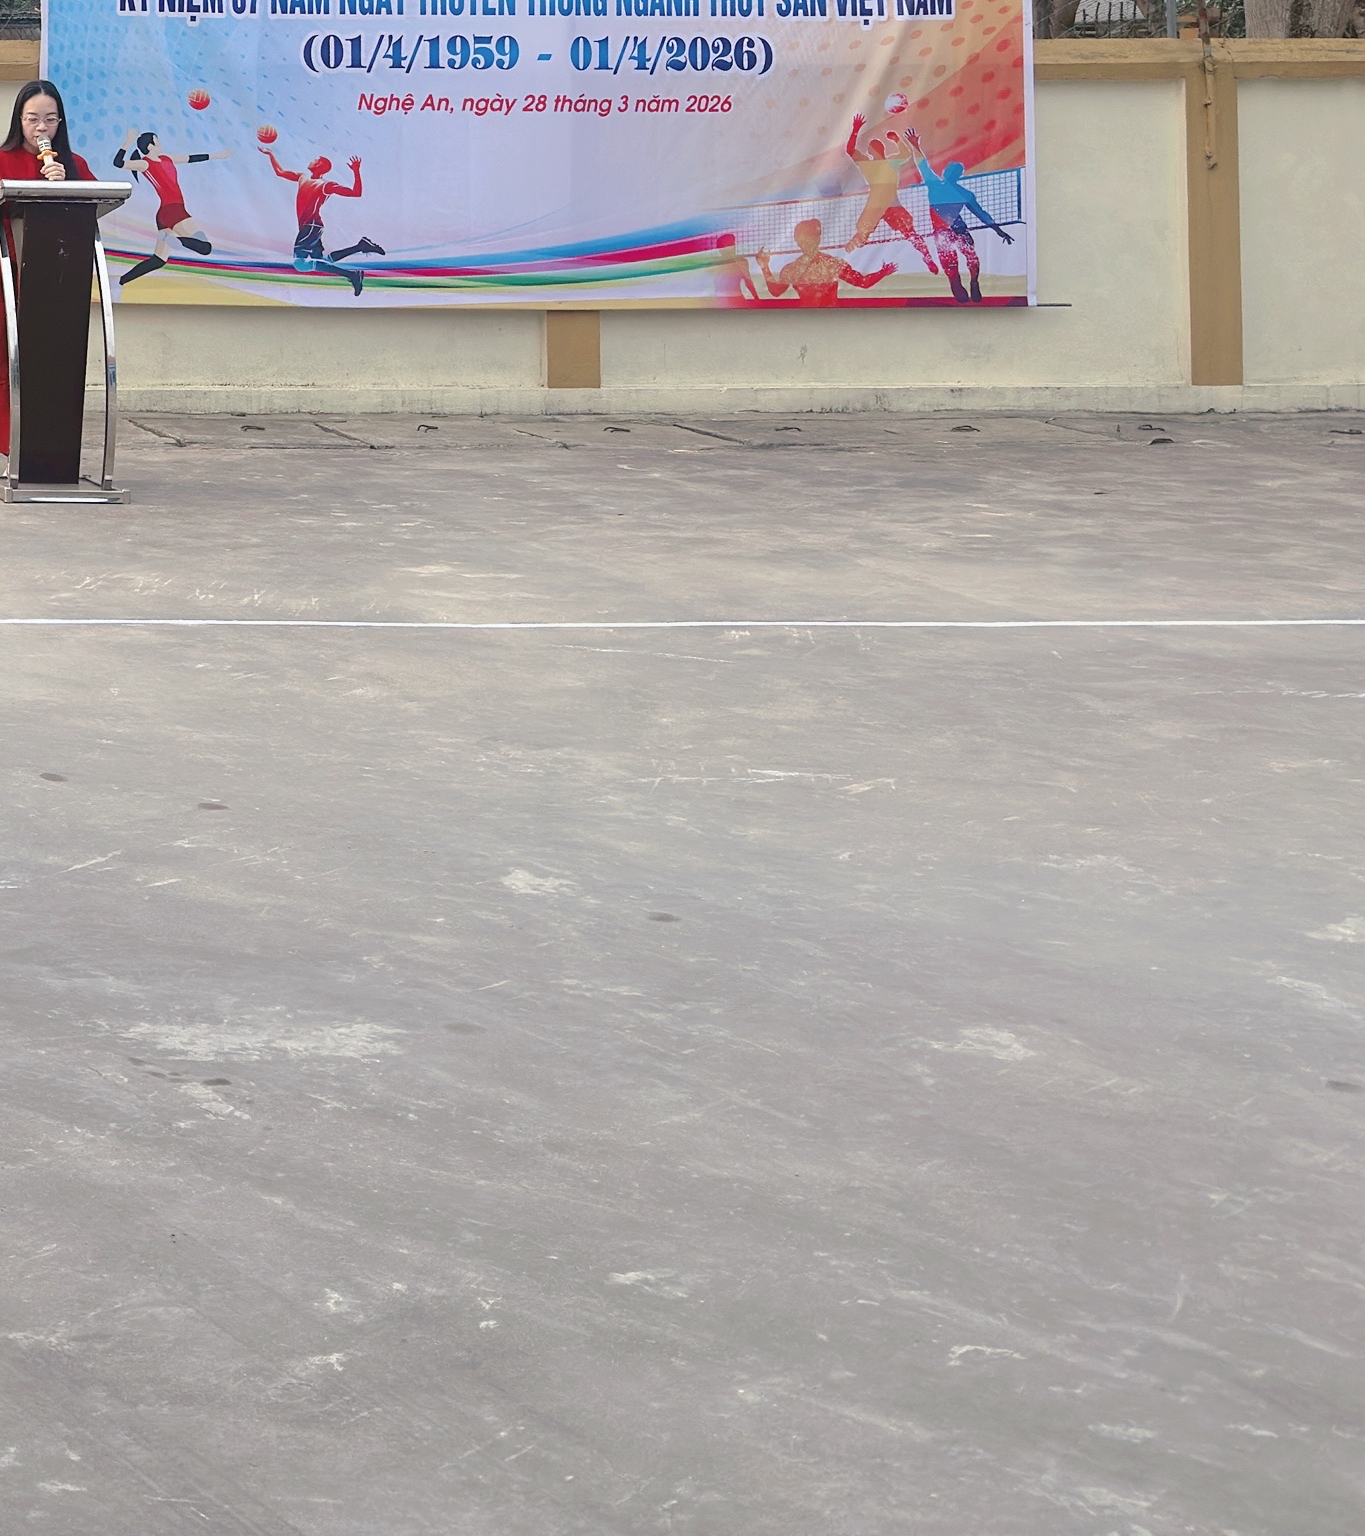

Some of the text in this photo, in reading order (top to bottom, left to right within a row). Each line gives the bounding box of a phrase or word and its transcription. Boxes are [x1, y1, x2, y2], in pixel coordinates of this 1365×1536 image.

[303, 33, 520, 74] (01/4/1959
[570, 35, 773, 76] 01/4/2026)
[358, 93, 732, 118] Nghệ An, ngày 28 tháng 3 năm 2026
